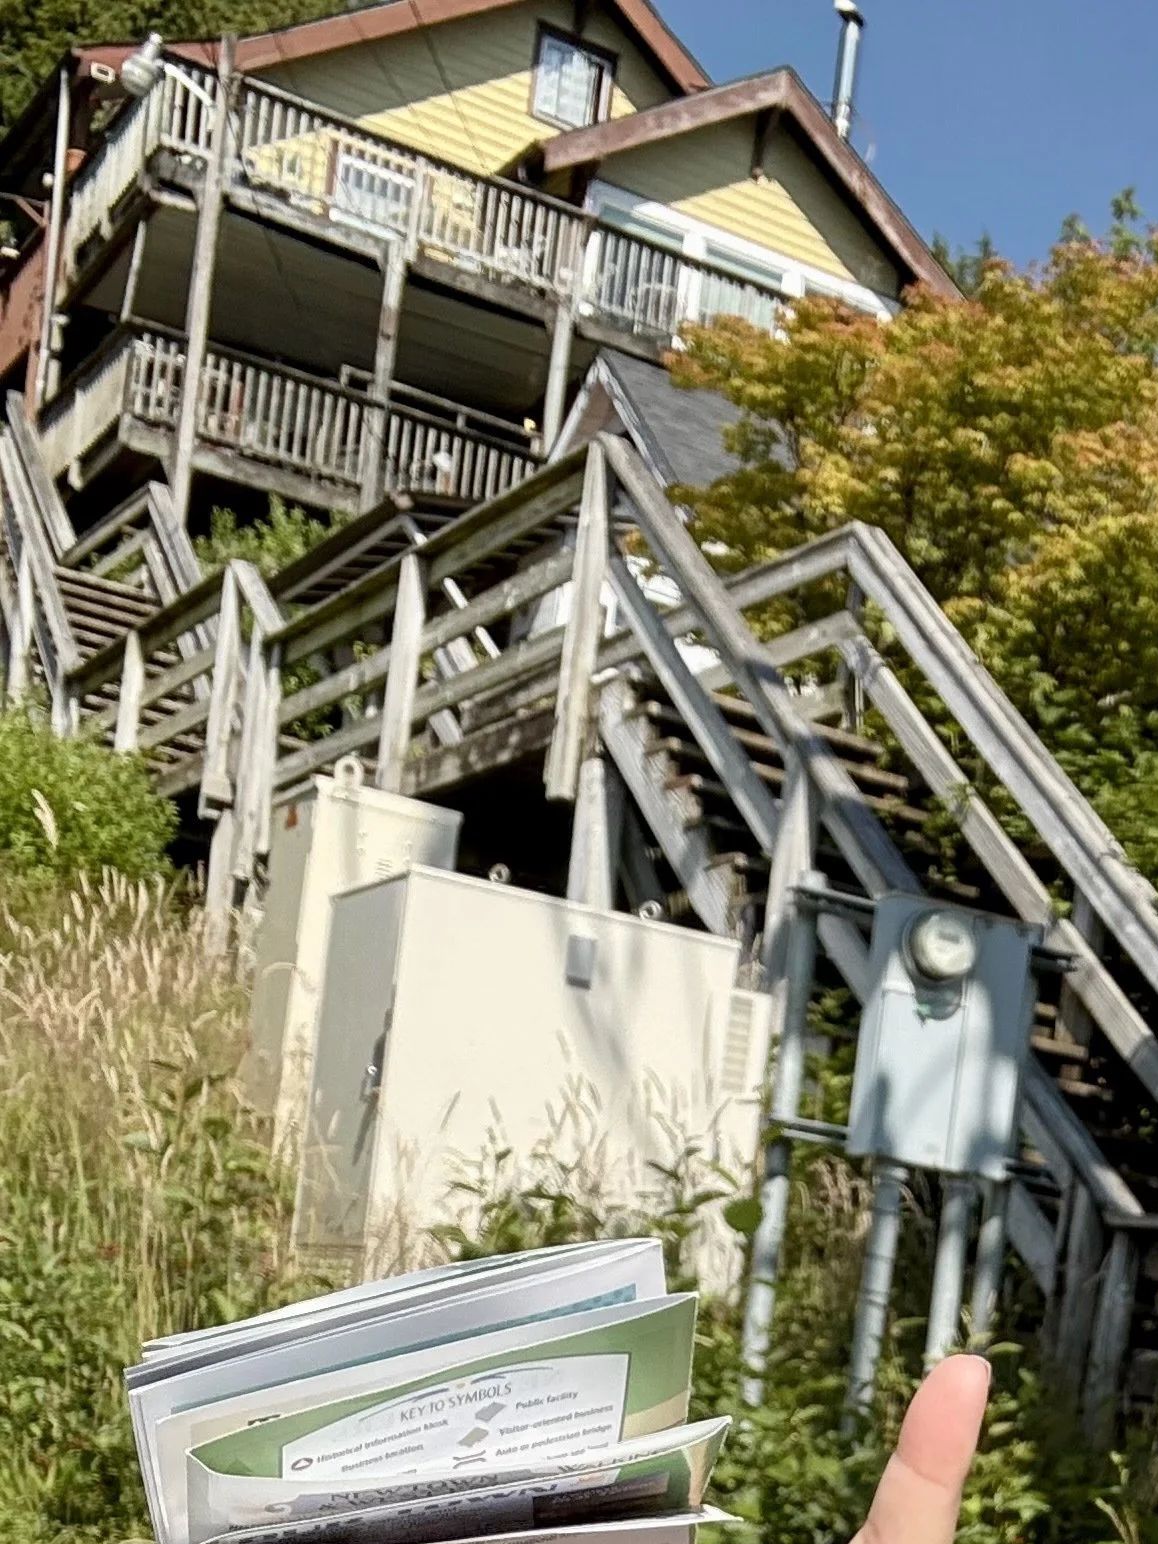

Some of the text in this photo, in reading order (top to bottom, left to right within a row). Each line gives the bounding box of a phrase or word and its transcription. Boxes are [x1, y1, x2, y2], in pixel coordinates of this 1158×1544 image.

[400, 1383, 512, 1422] KEY TO SYMBOLS
[515, 1390, 579, 1410] Public facility
[499, 1404, 613, 1436] Visitor-oriented business
[495, 1445, 518, 1457] Auto
